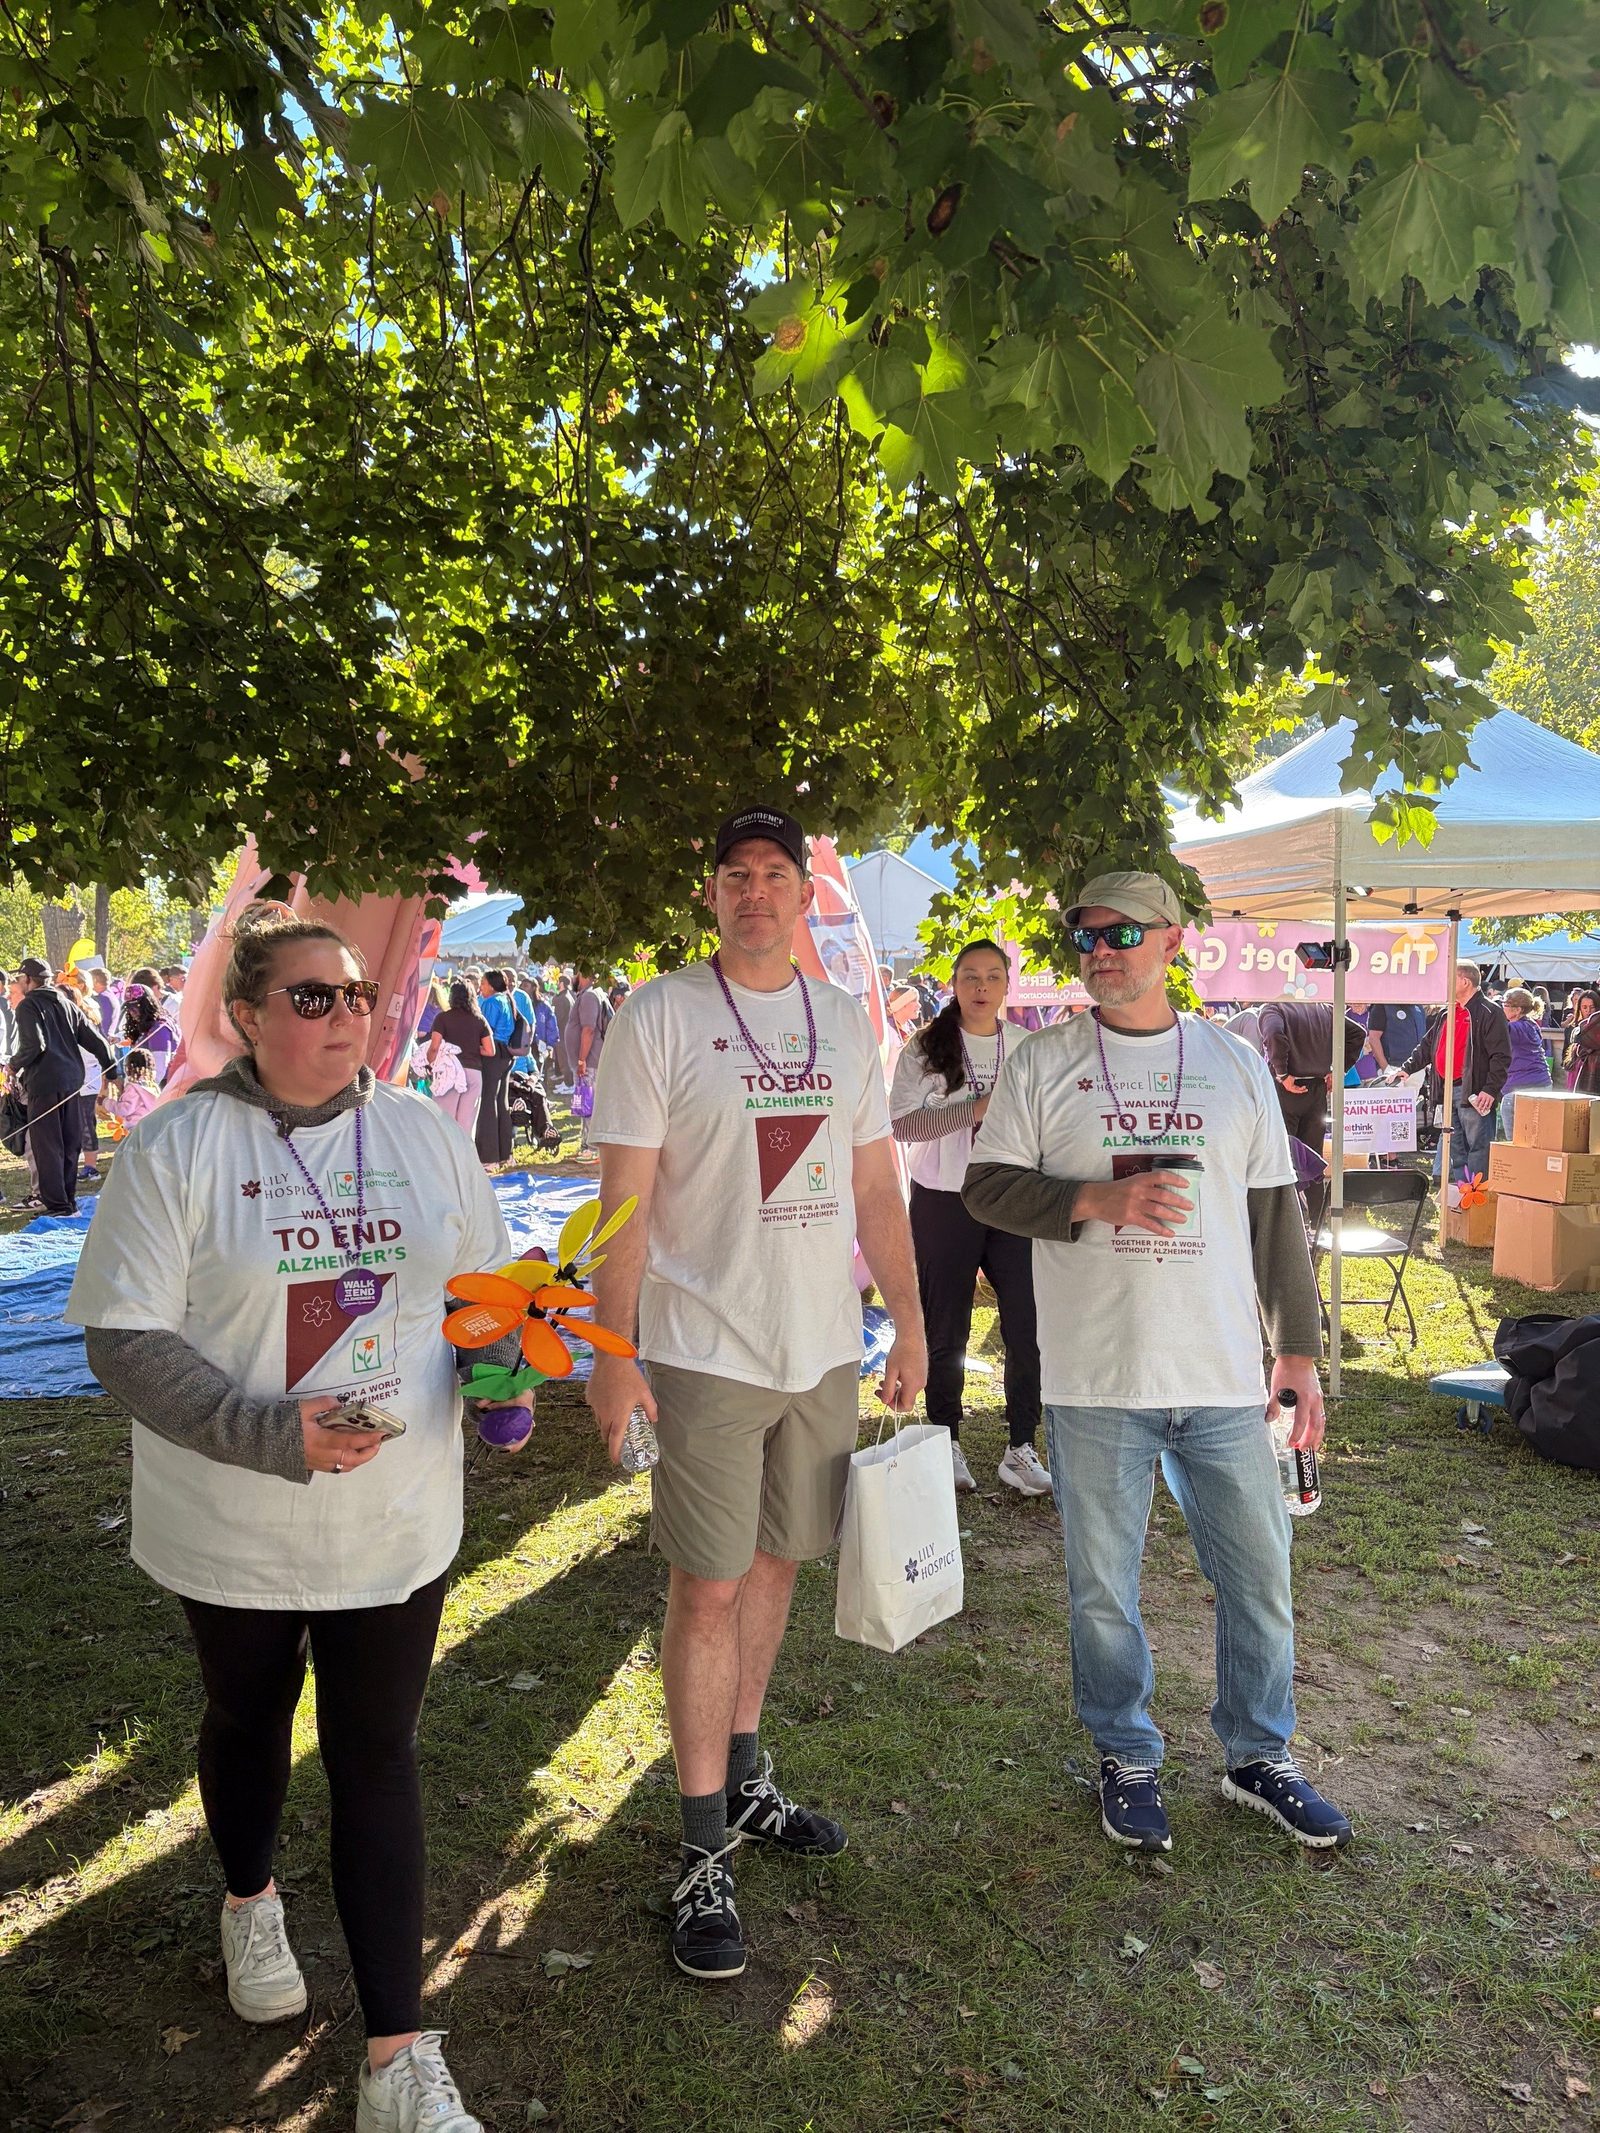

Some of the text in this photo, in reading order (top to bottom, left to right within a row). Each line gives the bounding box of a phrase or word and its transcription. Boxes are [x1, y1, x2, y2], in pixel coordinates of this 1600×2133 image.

[759, 1061, 809, 1070] WALKING
[740, 1073, 832, 1093] TO END
[965, 1081, 985, 1092] TO
[1199, 1081, 1216, 1091] Care
[745, 1096, 834, 1109] ALZHEIMER'S
[1124, 1100, 1178, 1109] WALKING
[1343, 1104, 1413, 1116] RAIN HEALTH
[1101, 1112, 1204, 1132] TO END
[1102, 1135, 1206, 1148] ALZHEIMER'S
[263, 1173, 289, 1187] LILY
[388, 1178, 411, 1188] Care
[301, 1207, 368, 1220] WALKING
[757, 1205, 798, 1215] TOGETHER
[799, 1204, 813, 1212] FOR
[761, 1209, 839, 1223] WITHOUT ALZHEIMER'S
[273, 1219, 402, 1252] TO END
[1153, 1248, 1204, 1256] ALZHEIMER'S
[276, 1247, 407, 1274] ALZHEIMER'S
[343, 1280, 375, 1290] WALK
[352, 1288, 376, 1297] END
[470, 1321, 502, 1337] WALK
[359, 1388, 366, 1396] A
[369, 1377, 402, 1393] WORLD
[918, 1542, 935, 1563] LILY
[920, 1549, 956, 1581] HOSPICE
